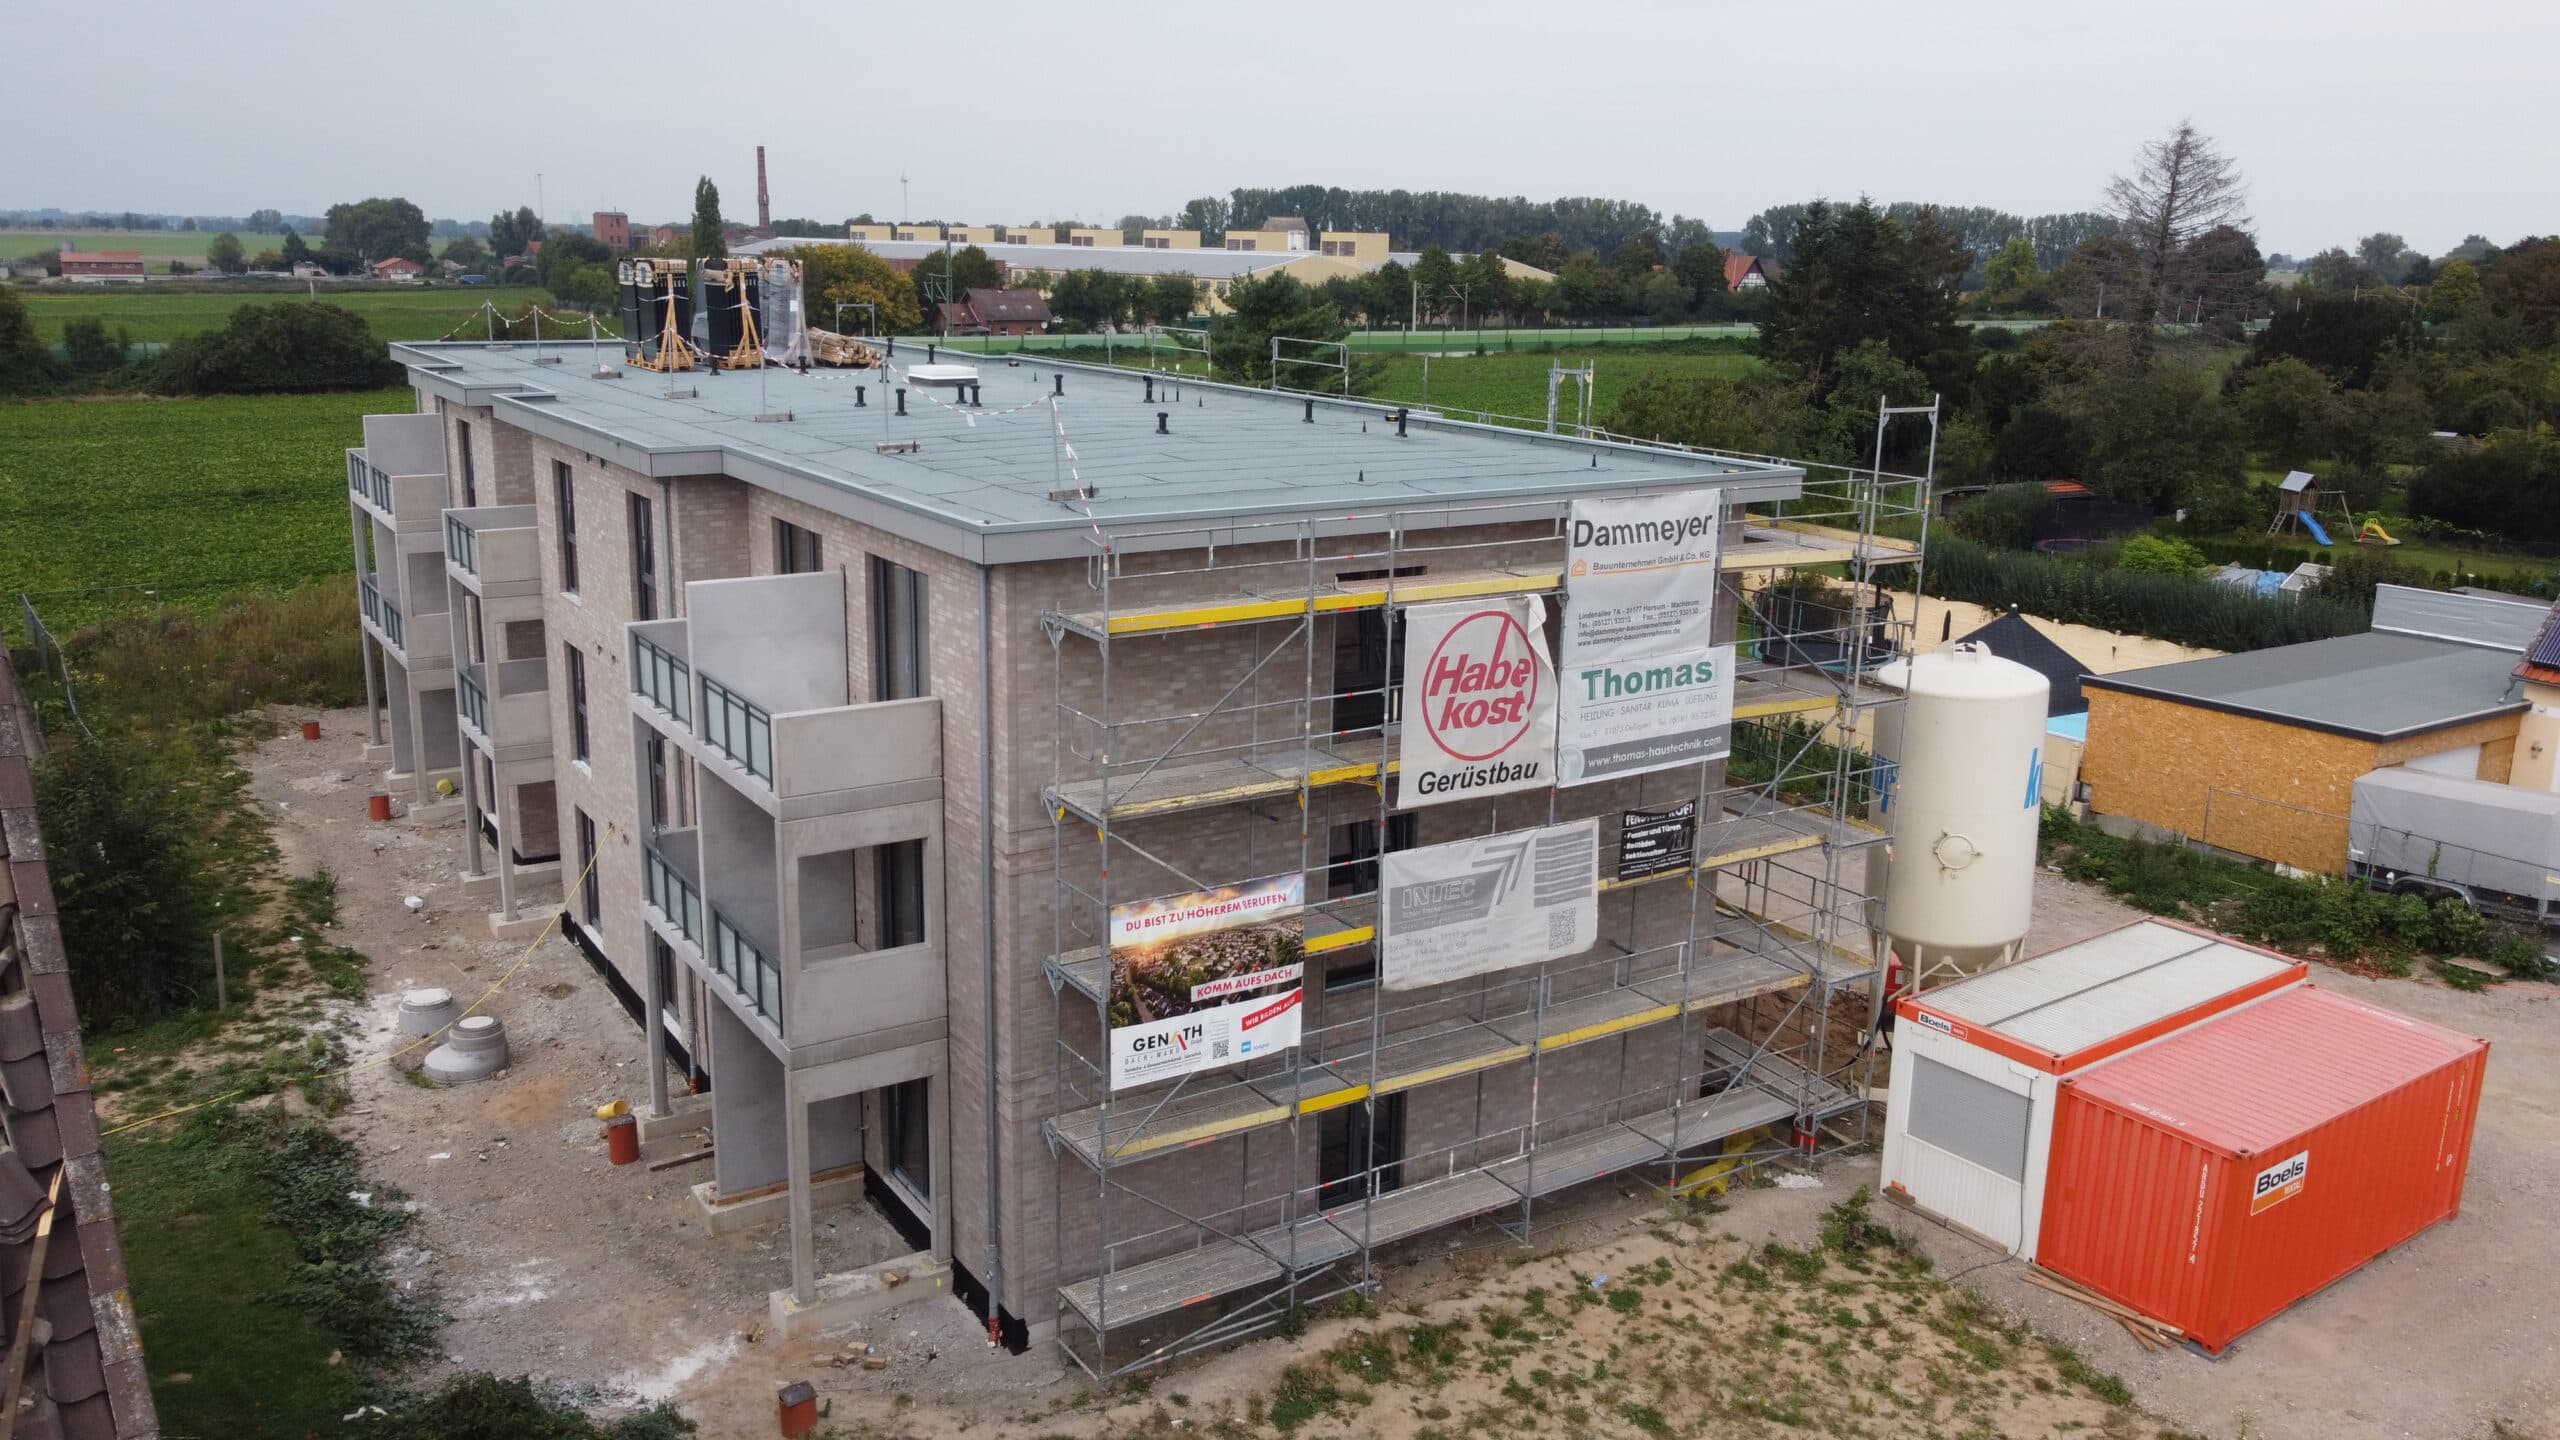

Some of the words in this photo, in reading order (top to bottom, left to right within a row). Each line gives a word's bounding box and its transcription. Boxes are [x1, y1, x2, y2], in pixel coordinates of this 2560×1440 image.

[1573, 514, 1713, 548] Dammeyer
[1593, 559, 1656, 571] Bauunternehmen
[1658, 554, 1679, 565] GmbH
[1699, 550, 1711, 559] KG
[1429, 650, 1531, 696] Habe
[1581, 661, 1713, 700] Thomas
[1438, 690, 1526, 731] kost
[1580, 708, 1614, 721] HEIZUNG
[1588, 735, 1722, 768] www.thomas-haustechnik.com
[1418, 761, 1538, 795] Gerüstbau
[1402, 879, 1476, 909] INTEC
[1126, 921, 1141, 932] DU
[1144, 915, 1166, 928] BIST
[1169, 911, 1185, 923] ZU
[1187, 902, 1241, 919] HÖHEREM
[1242, 893, 1287, 910] BERUFEN
[1197, 982, 1232, 998] KOMM
[1235, 975, 1262, 989] AUFS
[1264, 969, 1293, 983] DACH
[1245, 1015, 1259, 1027] WIR
[1920, 1014, 1950, 1031] Boels
[2257, 1161, 2304, 1195] Boels
